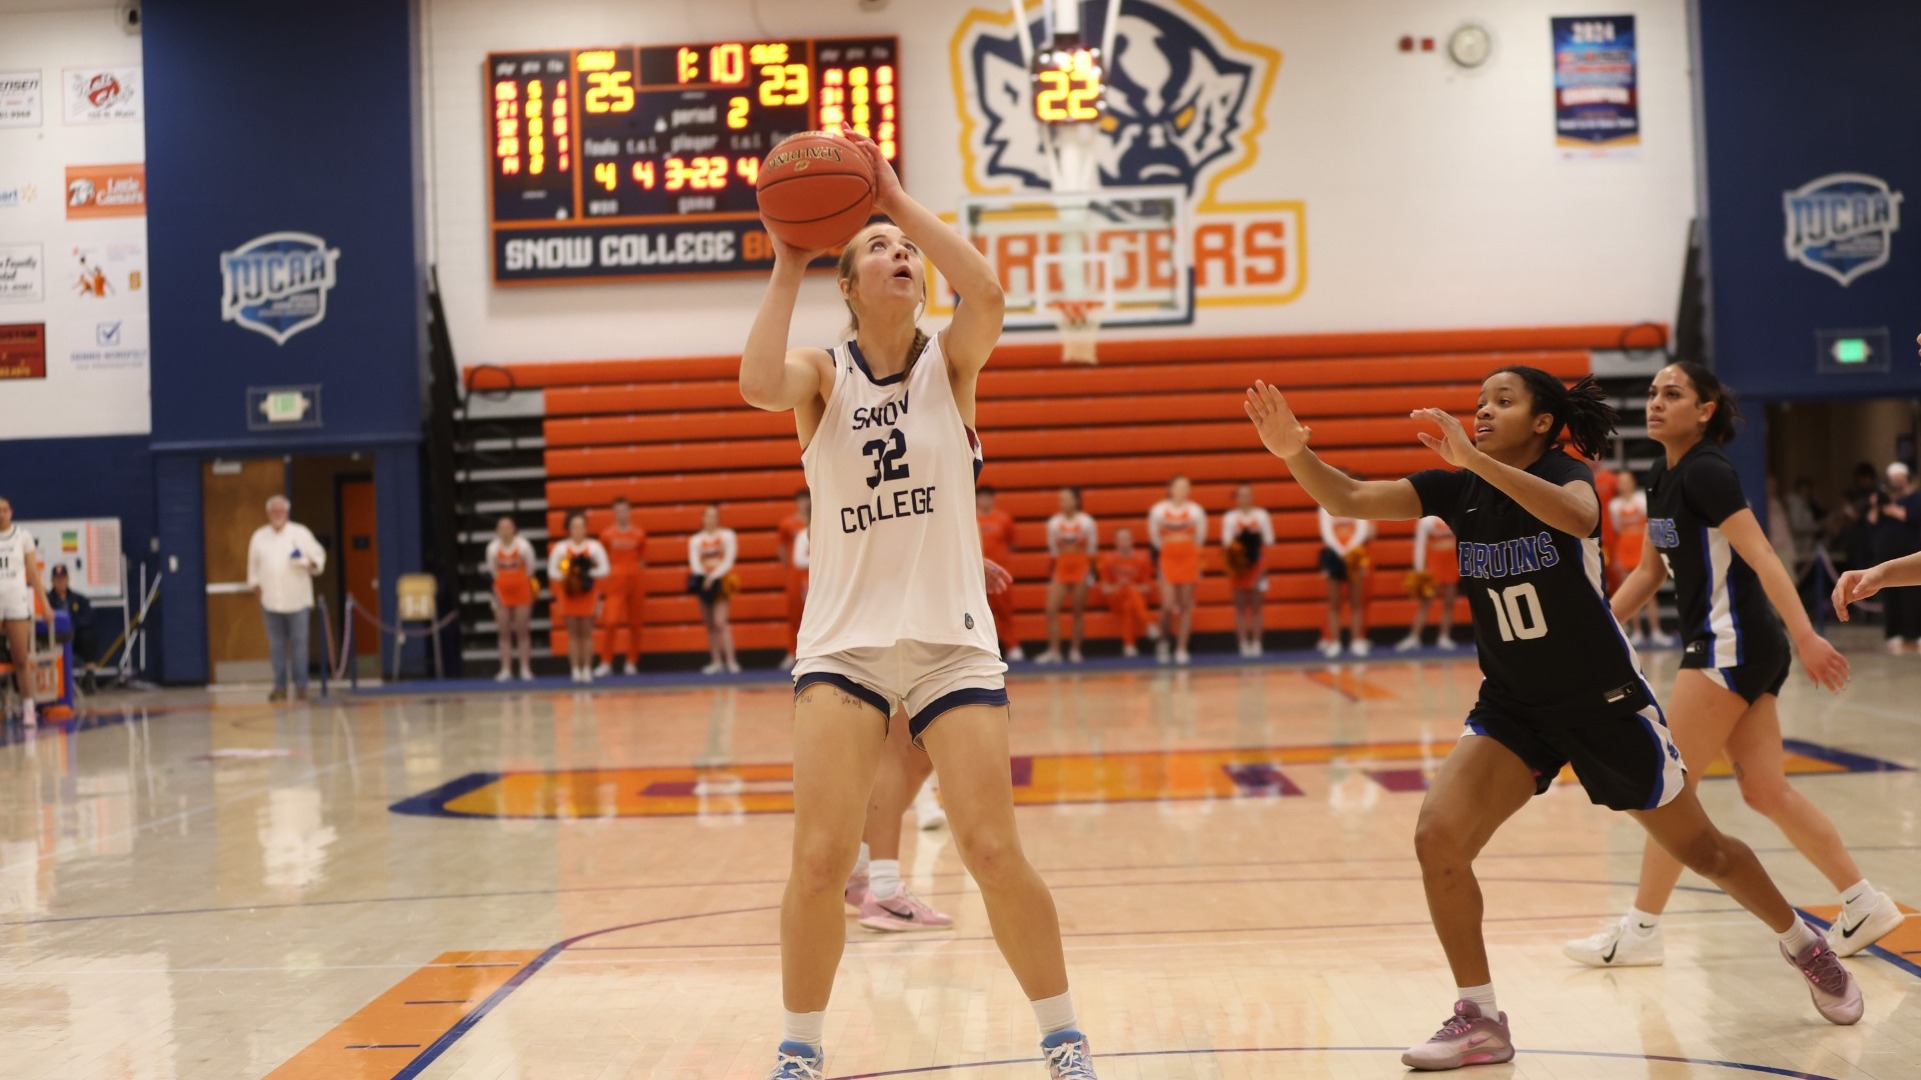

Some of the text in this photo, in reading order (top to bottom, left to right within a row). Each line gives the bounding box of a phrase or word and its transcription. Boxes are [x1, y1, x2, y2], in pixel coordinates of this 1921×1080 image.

[676, 43, 744, 84] 1:10
[759, 63, 809, 107] 23
[585, 70, 635, 113] 25
[727, 97, 749, 129] 2
[1037, 70, 1100, 121] 22
[594, 162, 617, 191] 4
[632, 160, 655, 190] 4
[664, 156, 728, 190] 3-22
[736, 157, 759, 187] 4
[767, 147, 843, 171] SPALDING
[1788, 191, 1893, 247] NJCAA
[506, 237, 593, 271] SNOW
[600, 230, 736, 268] COLLEGE
[947, 220, 1287, 295] AGERS
[224, 251, 327, 307] NJCAA
[862, 428, 910, 490] 32
[841, 486, 936, 534] COLEGE
[1458, 531, 1560, 579] BRUINS
[1487, 582, 1548, 642] 10
